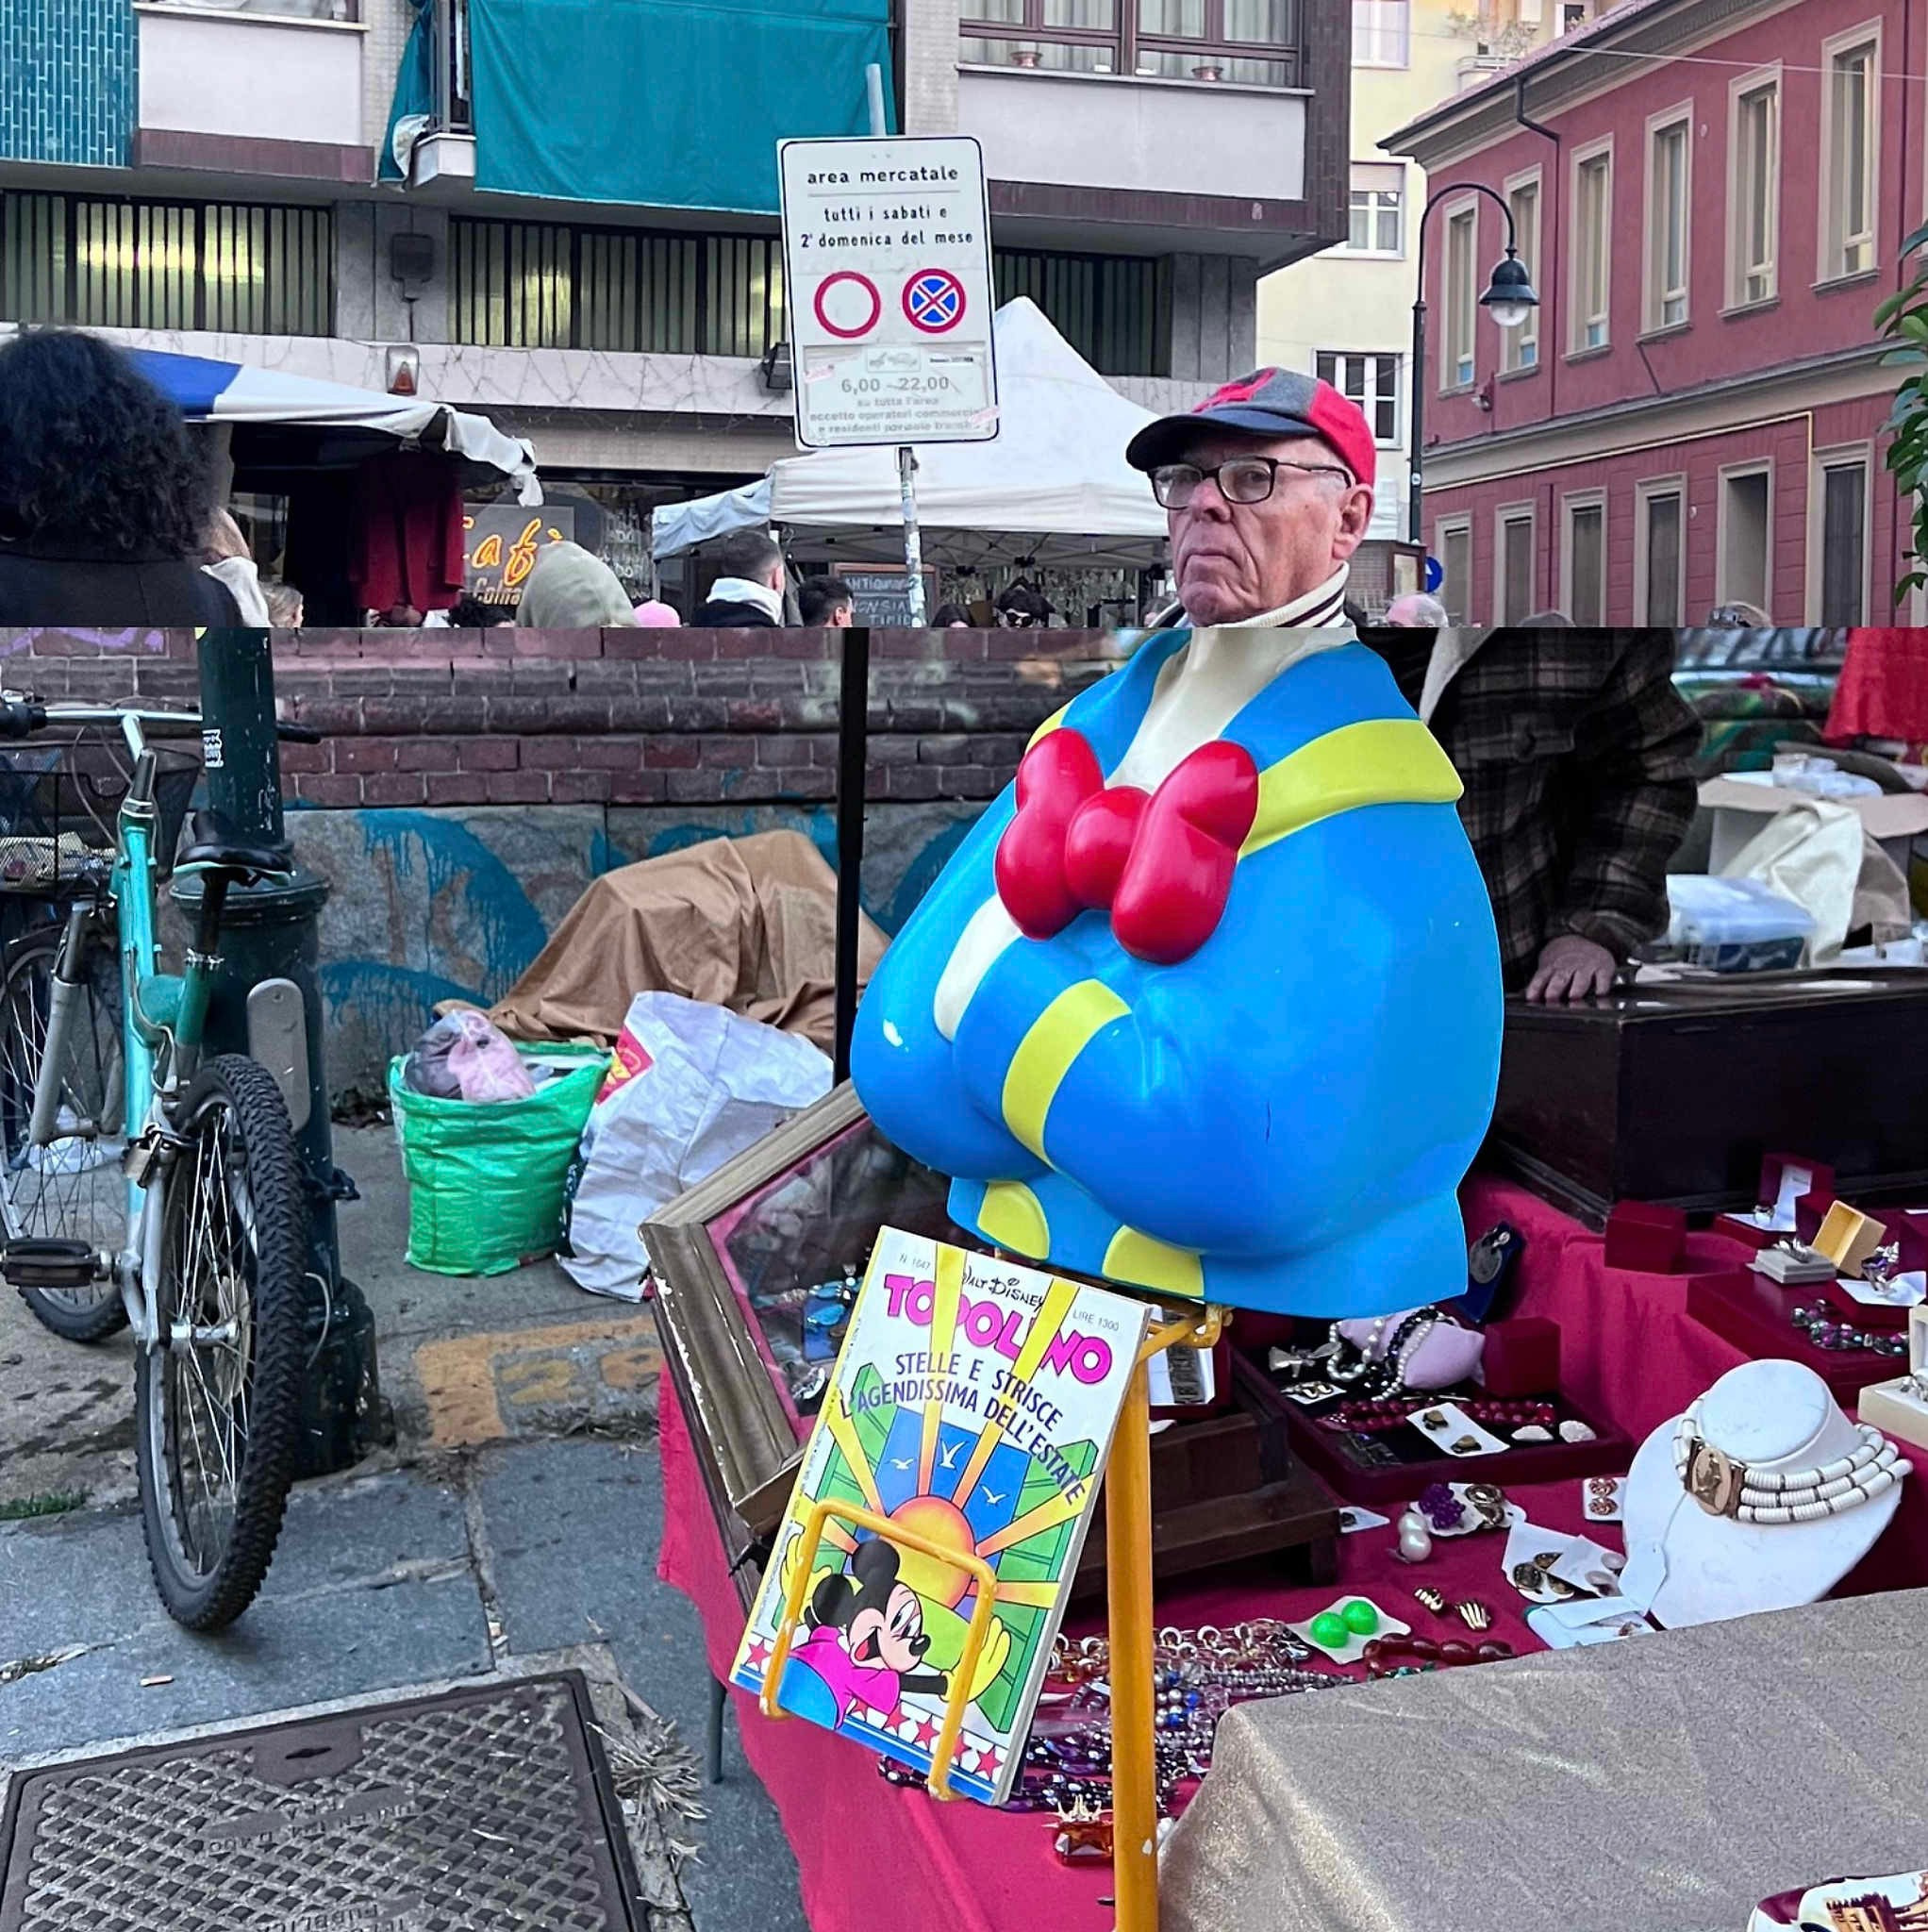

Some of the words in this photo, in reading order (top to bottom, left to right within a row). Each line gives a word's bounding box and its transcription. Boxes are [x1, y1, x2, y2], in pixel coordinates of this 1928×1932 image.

[807, 171, 849, 185] area
[860, 165, 958, 183] mercatale
[824, 207, 859, 222] tutti
[869, 206, 874, 220] i
[883, 205, 930, 220] sabati
[939, 208, 947, 219] e
[818, 231, 891, 247] domenica
[902, 230, 923, 245] del
[935, 233, 972, 245] mese
[841, 378, 880, 395] 6,00
[898, 376, 949, 392] 22,00
[875, 396, 903, 408] tutta
[810, 411, 855, 422] eccetto
[858, 408, 913, 422] operatori
[884, 1274, 1113, 1385] TOOLNO
[895, 1352, 961, 1375] STELLE
[969, 1358, 984, 1382] E
[991, 1369, 1064, 1432] STRISCE
[983, 1397, 1086, 1507] DELL'ESTATE
